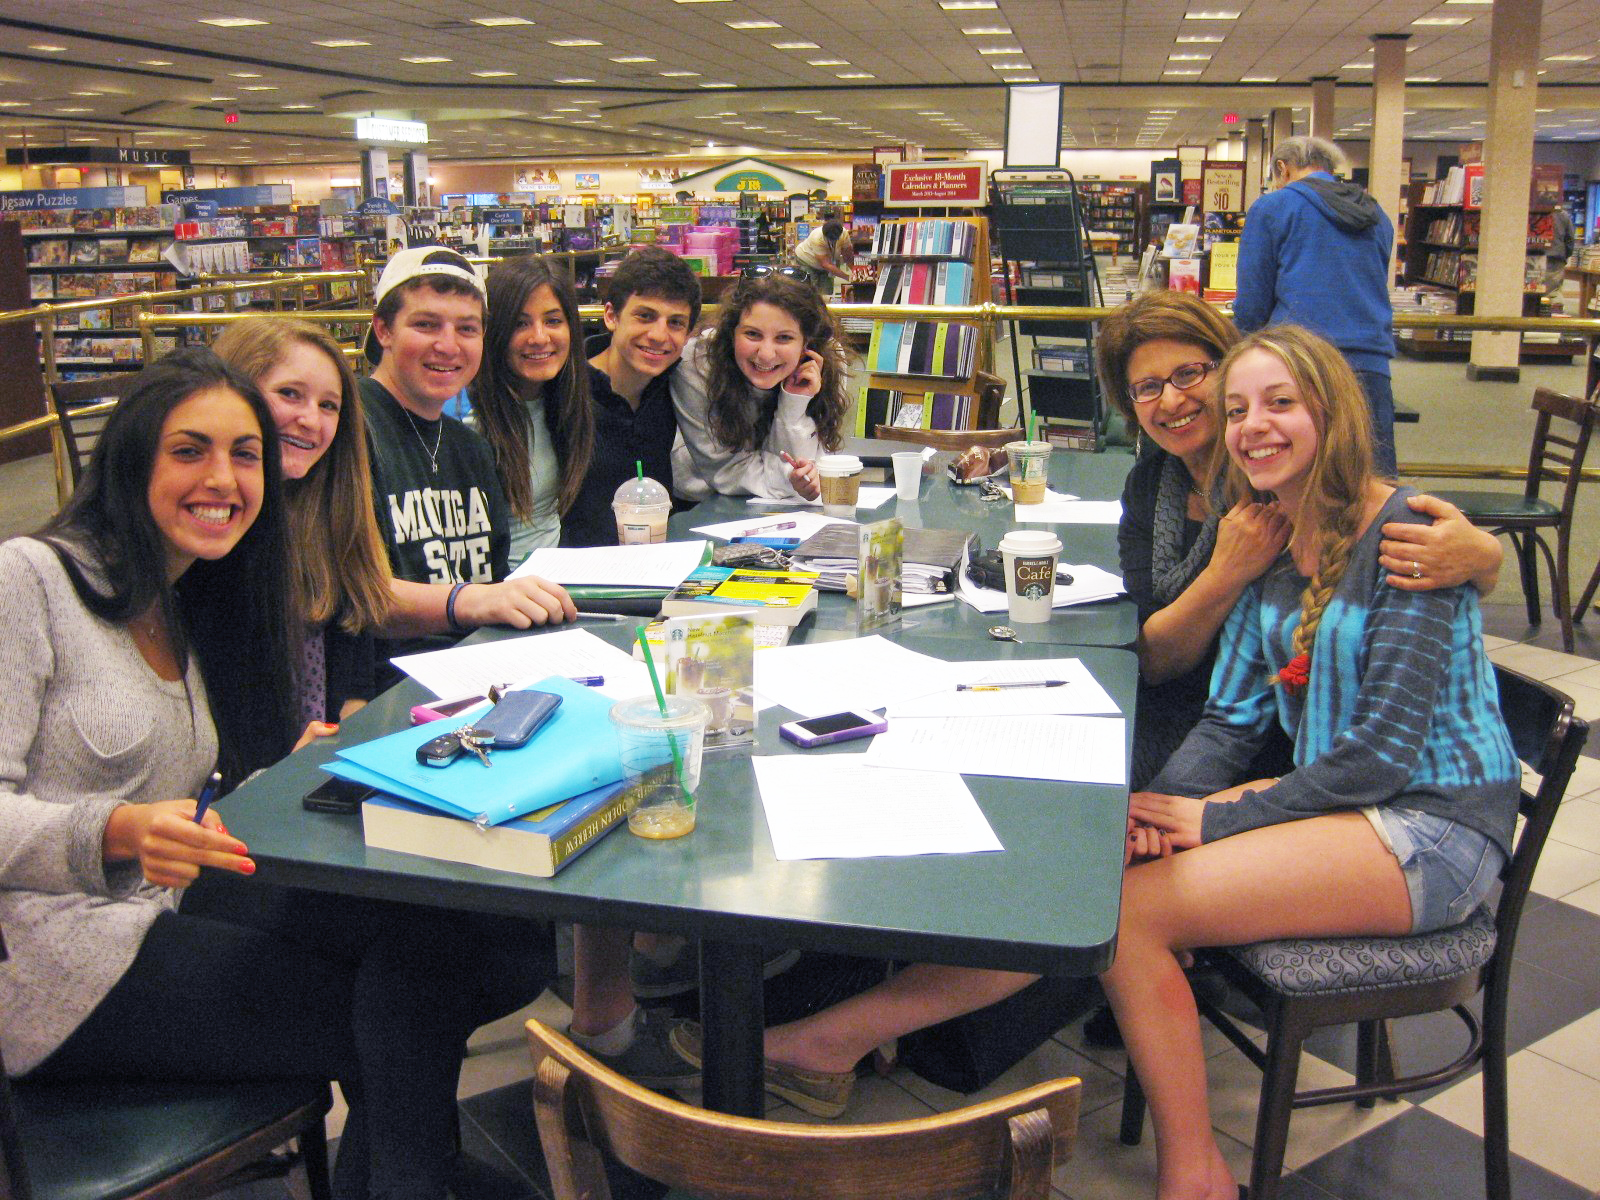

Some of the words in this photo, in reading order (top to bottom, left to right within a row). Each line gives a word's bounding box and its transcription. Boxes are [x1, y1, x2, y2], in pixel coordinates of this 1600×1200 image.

[119, 149, 168, 162] MUSIC
[904, 174, 932, 182] Exclusive
[934, 172, 966, 181] 18-Month
[902, 182, 932, 190] Calendars
[939, 181, 967, 189] Planners
[1, 194, 34, 210] Jigsaw
[37, 193, 78, 206] Puzzles
[166, 194, 199, 204] Games
[1213, 192, 1229, 210] $10
[1017, 566, 1051, 580] Café
[565, 821, 599, 855] HEBREW
